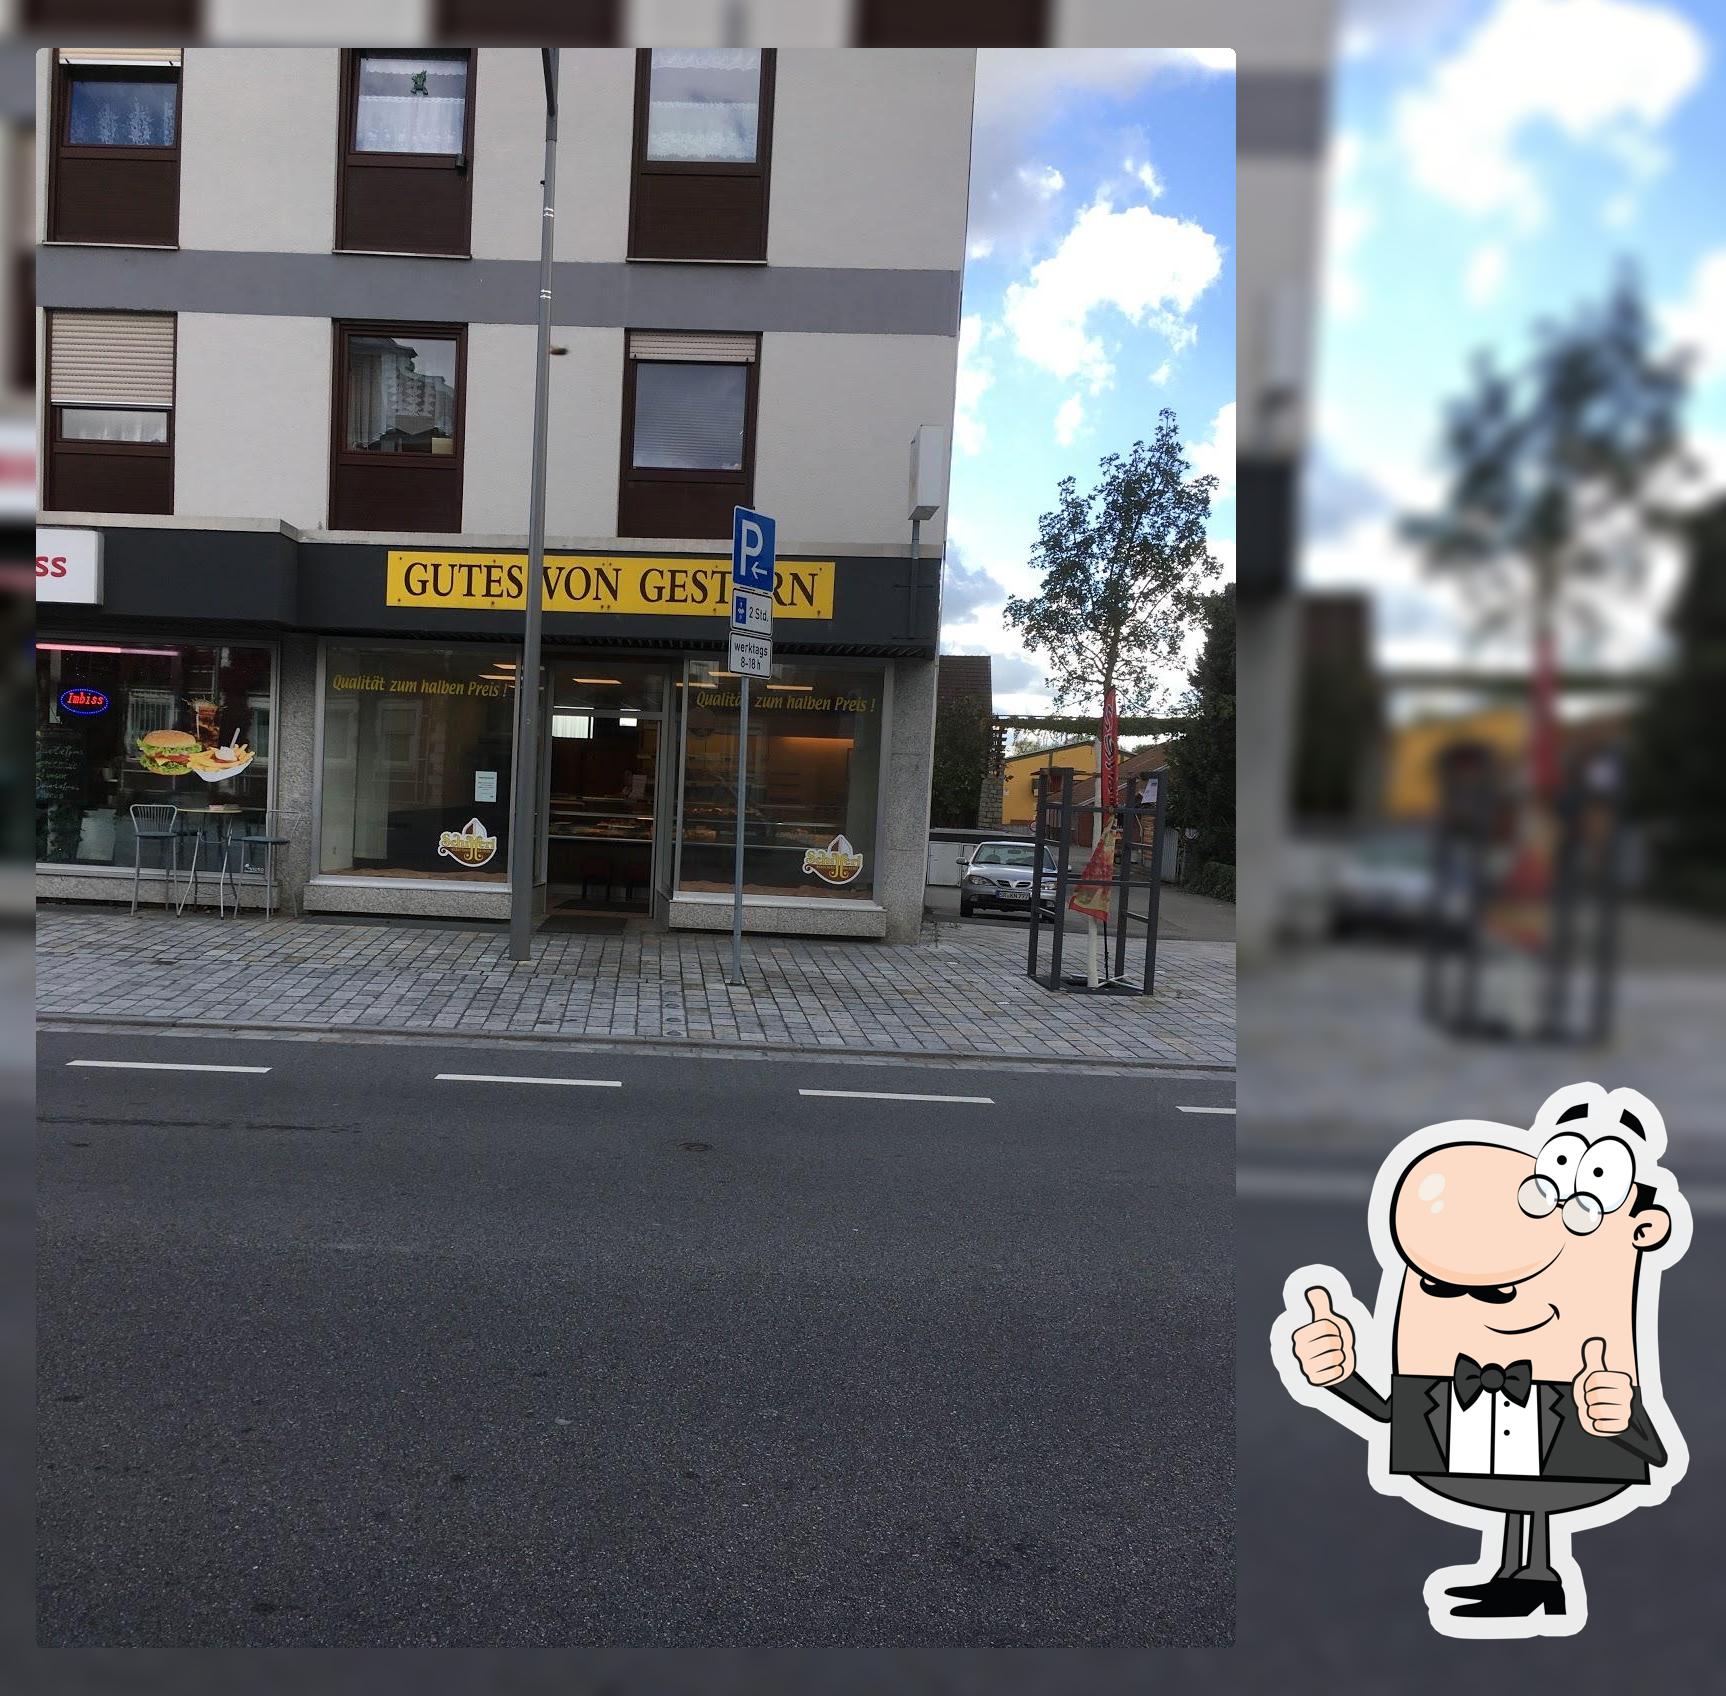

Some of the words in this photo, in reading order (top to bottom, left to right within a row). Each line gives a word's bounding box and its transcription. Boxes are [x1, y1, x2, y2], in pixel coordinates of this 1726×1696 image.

[740, 519, 763, 576] P
[404, 562, 523, 599] GUTES
[542, 566, 622, 601] VON
[639, 568, 818, 607] GESTRN
[748, 606, 754, 619] 2
[755, 608, 769, 622] Std.
[734, 642, 768, 659] werktags
[332, 674, 385, 692] Qualität
[390, 679, 417, 693] zum
[420, 679, 465, 695] halben
[467, 681, 499, 697] Preis
[67, 692, 105, 706] Imbiss
[696, 690, 742, 709] Qualitä
[754, 695, 783, 710] zum
[785, 695, 831, 712] halben
[833, 697, 867, 713] Preis
